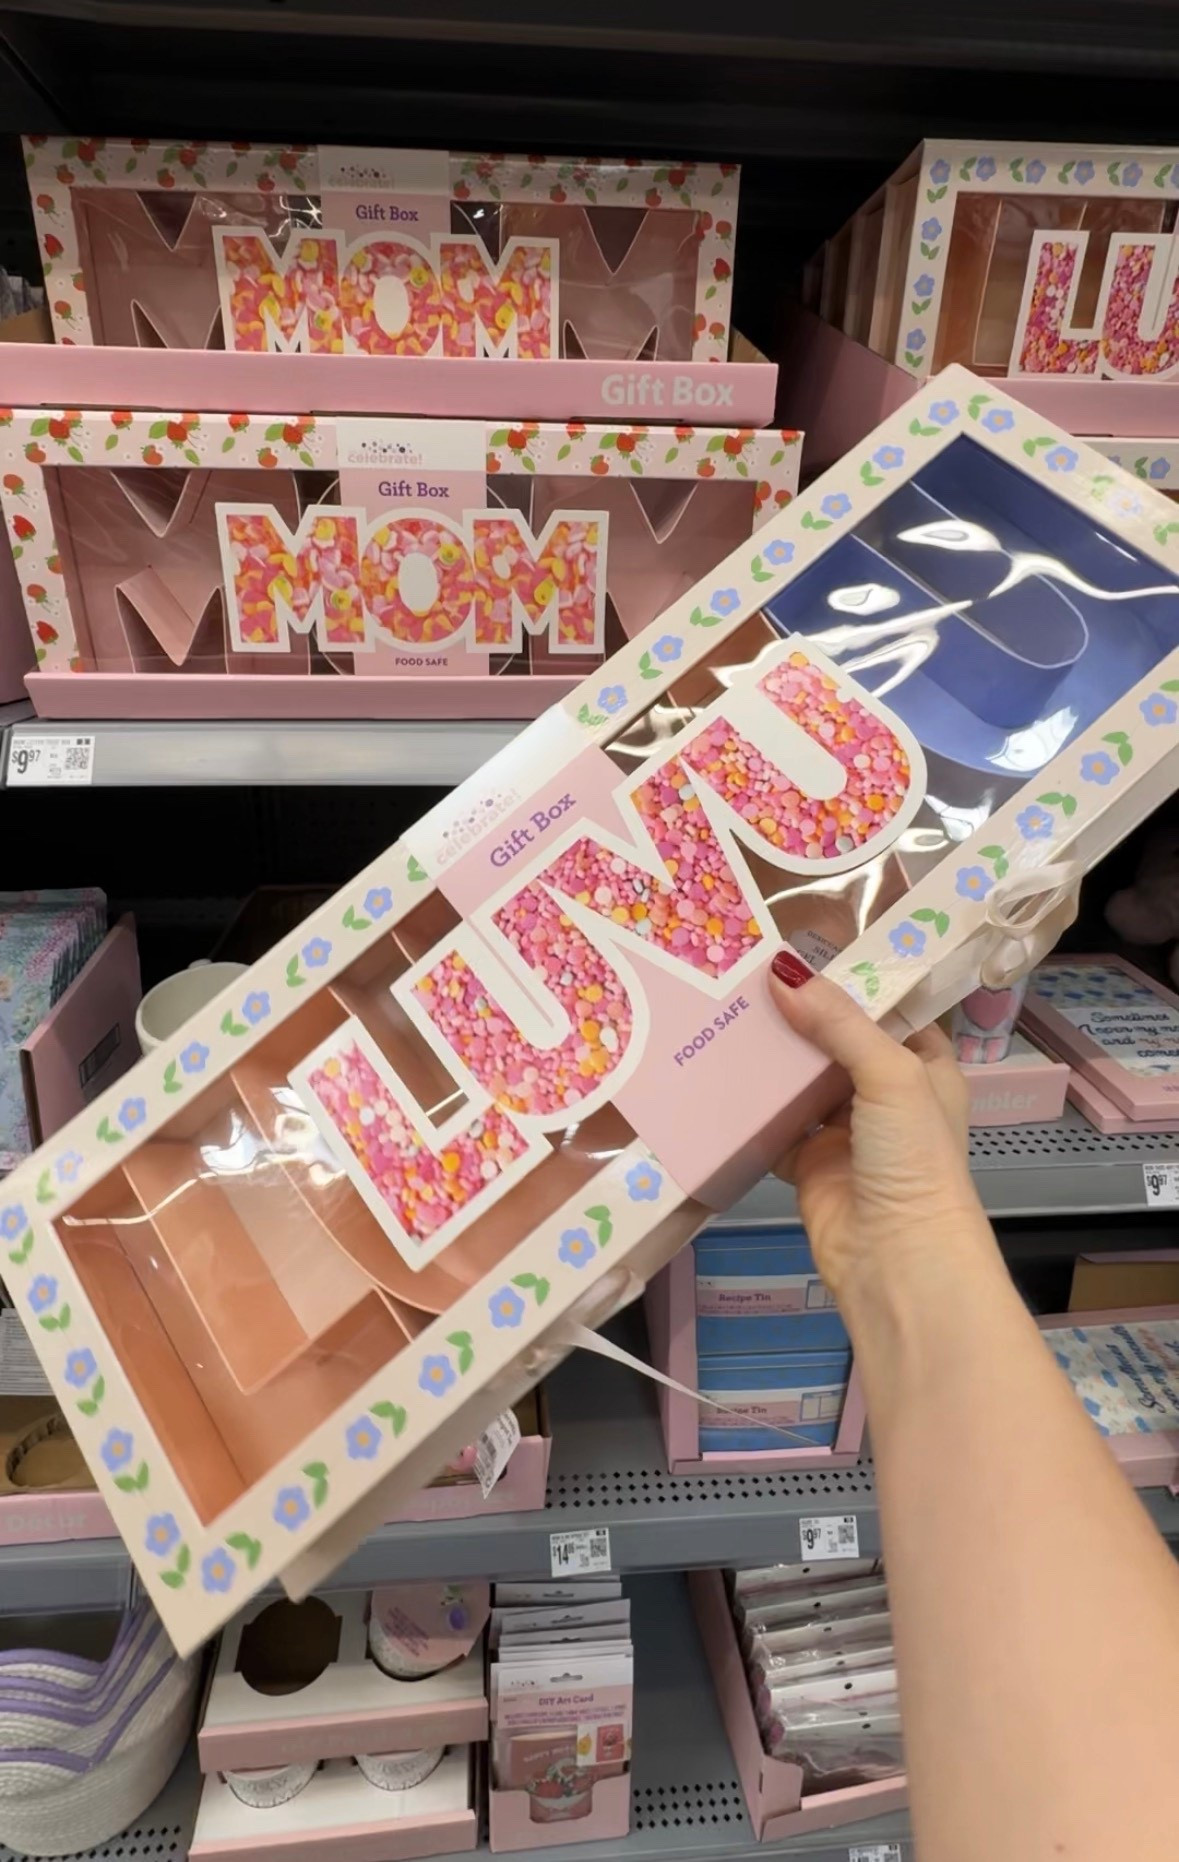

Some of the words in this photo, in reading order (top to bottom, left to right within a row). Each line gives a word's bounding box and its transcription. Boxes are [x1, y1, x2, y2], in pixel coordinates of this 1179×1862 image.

[356, 203, 386, 220] Gift
[389, 205, 419, 222] Box
[212, 226, 560, 360] MOM
[601, 373, 664, 405] Gift
[672, 376, 734, 406] Box
[347, 451, 423, 465] celebrate!
[378, 480, 413, 497] Gift
[416, 482, 450, 498] Box
[215, 502, 609, 654] MOM
[395, 657, 424, 667] FOOD
[425, 657, 449, 667] SAFE
[489, 829, 535, 868] Gift
[530, 793, 577, 833] Box
[674, 1027, 715, 1067] FOOD
[713, 996, 750, 1030] SAFE
